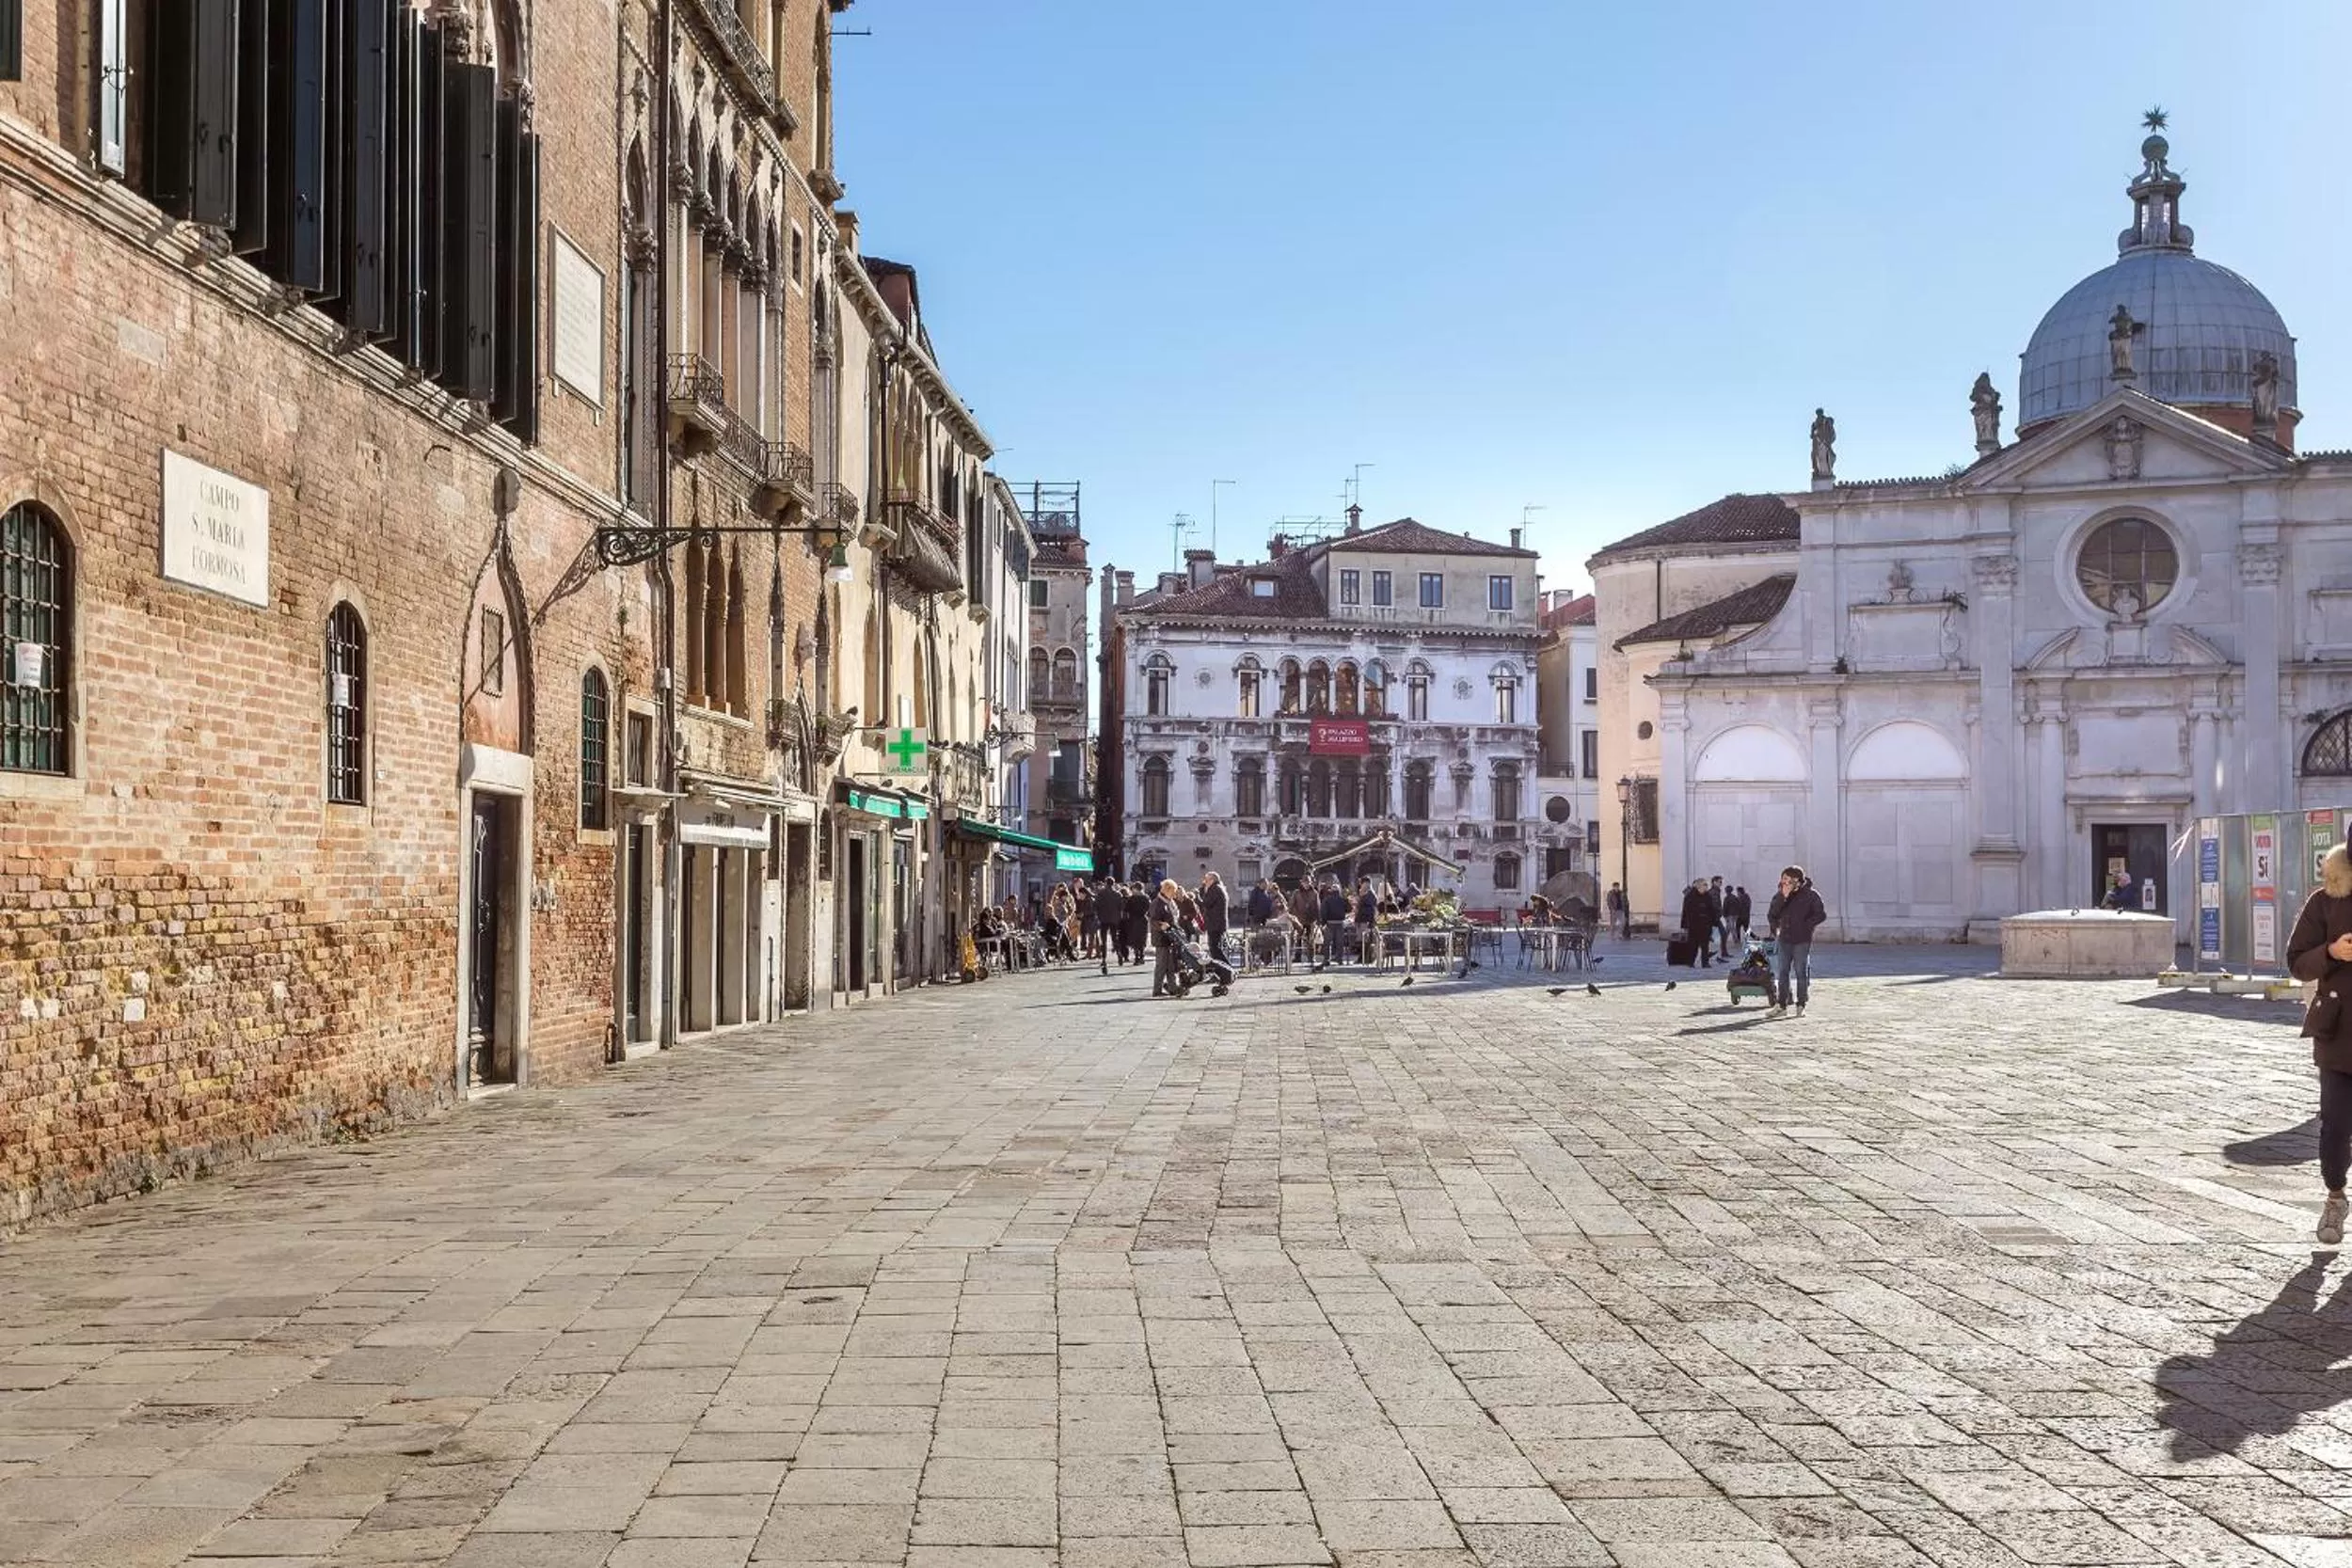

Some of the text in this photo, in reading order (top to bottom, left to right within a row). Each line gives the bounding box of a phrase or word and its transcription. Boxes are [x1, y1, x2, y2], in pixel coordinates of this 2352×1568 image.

[199, 480, 240, 513] CAMPO
[191, 512, 246, 549] S. MARIA
[192, 545, 246, 584] FORMOSA
